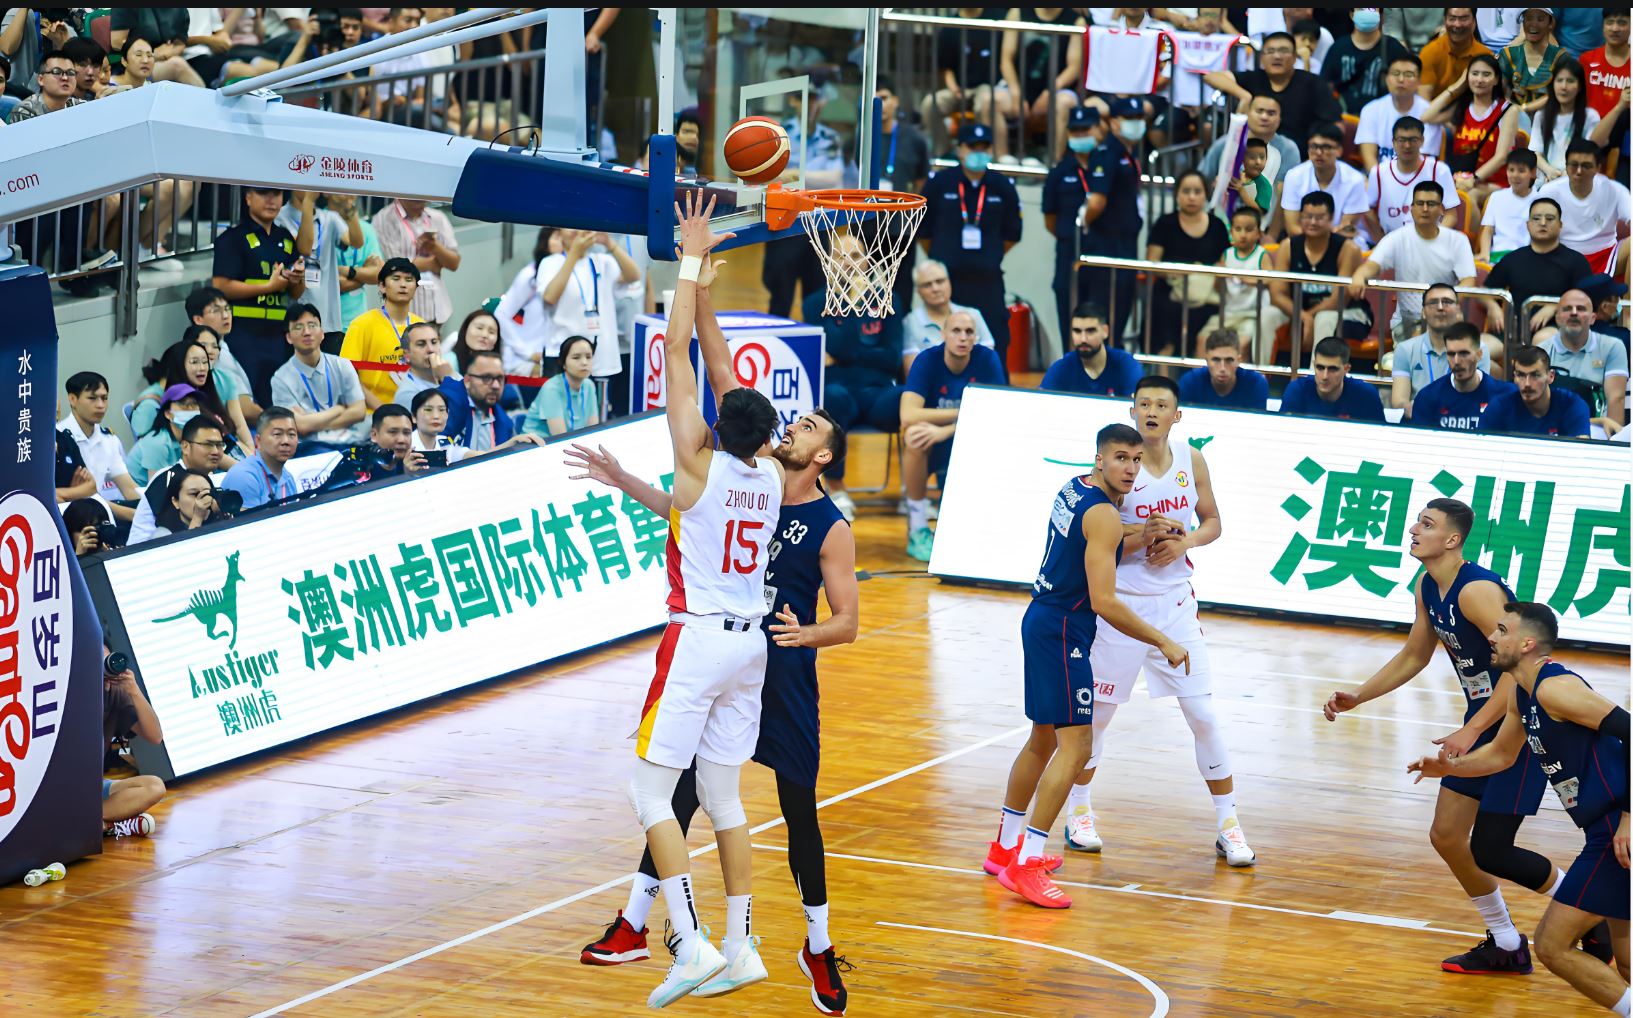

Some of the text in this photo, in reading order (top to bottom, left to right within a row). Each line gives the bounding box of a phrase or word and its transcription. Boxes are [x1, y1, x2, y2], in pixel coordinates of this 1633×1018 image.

[321, 156, 373, 173] 金陵体育
[0, 173, 40, 196] .com
[17, 348, 33, 464] 水中贵族
[725, 489, 755, 510] ZHOU
[1135, 495, 1189, 519] CHINA
[782, 519, 809, 545] 33
[721, 519, 765, 575] 15
[32, 544, 61, 740] 百岁山
[216, 689, 282, 737] 澳洲虎
